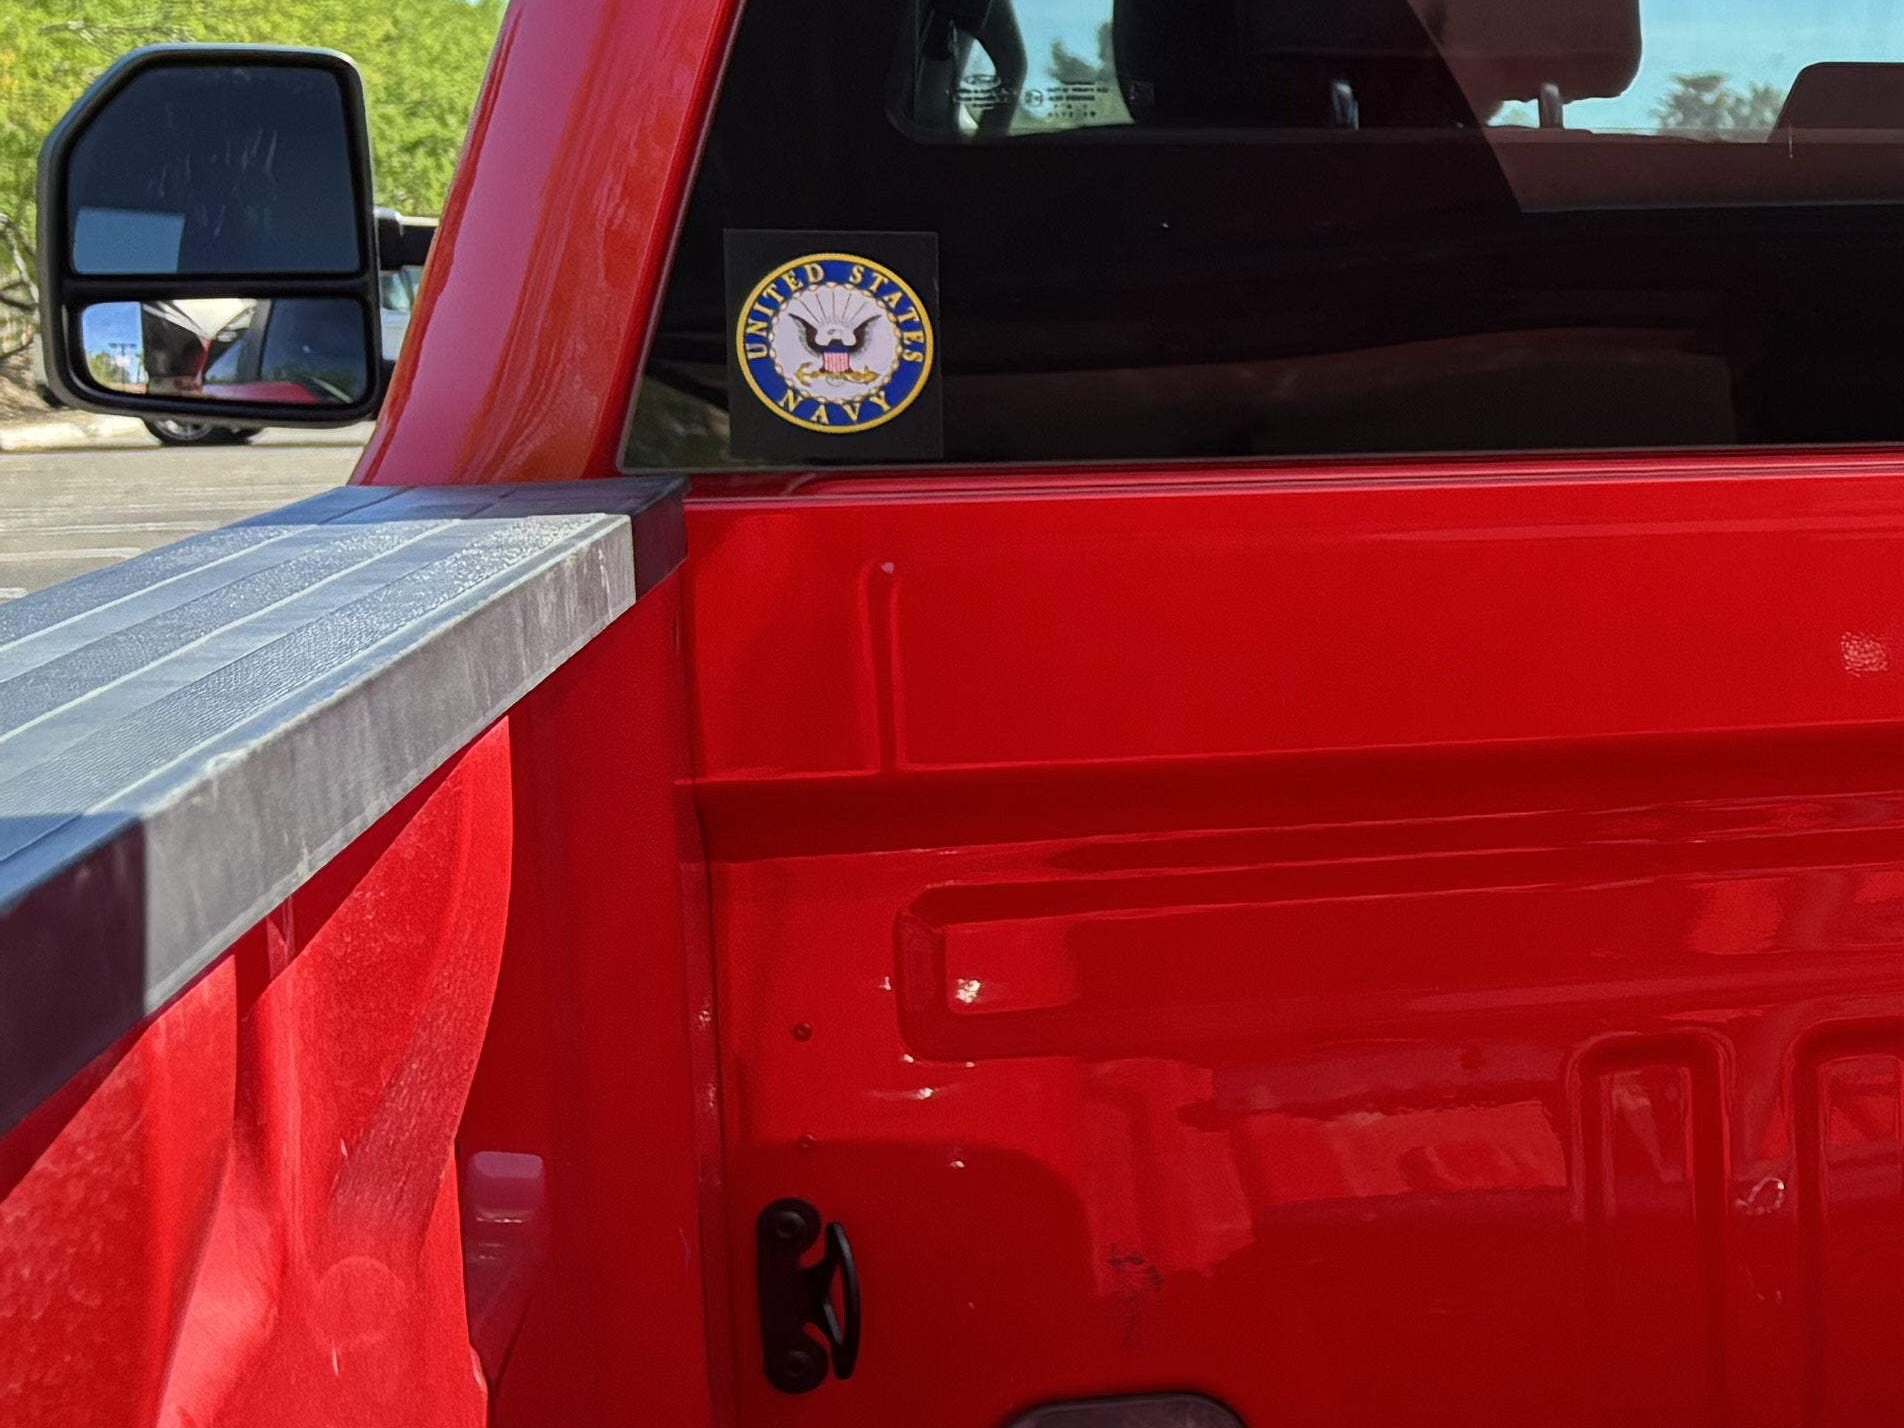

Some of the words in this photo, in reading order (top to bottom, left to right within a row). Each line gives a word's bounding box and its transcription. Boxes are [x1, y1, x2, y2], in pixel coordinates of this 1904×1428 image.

[745, 263, 825, 360] UNITED
[849, 264, 924, 364] STATES
[779, 389, 893, 425] NAVY
